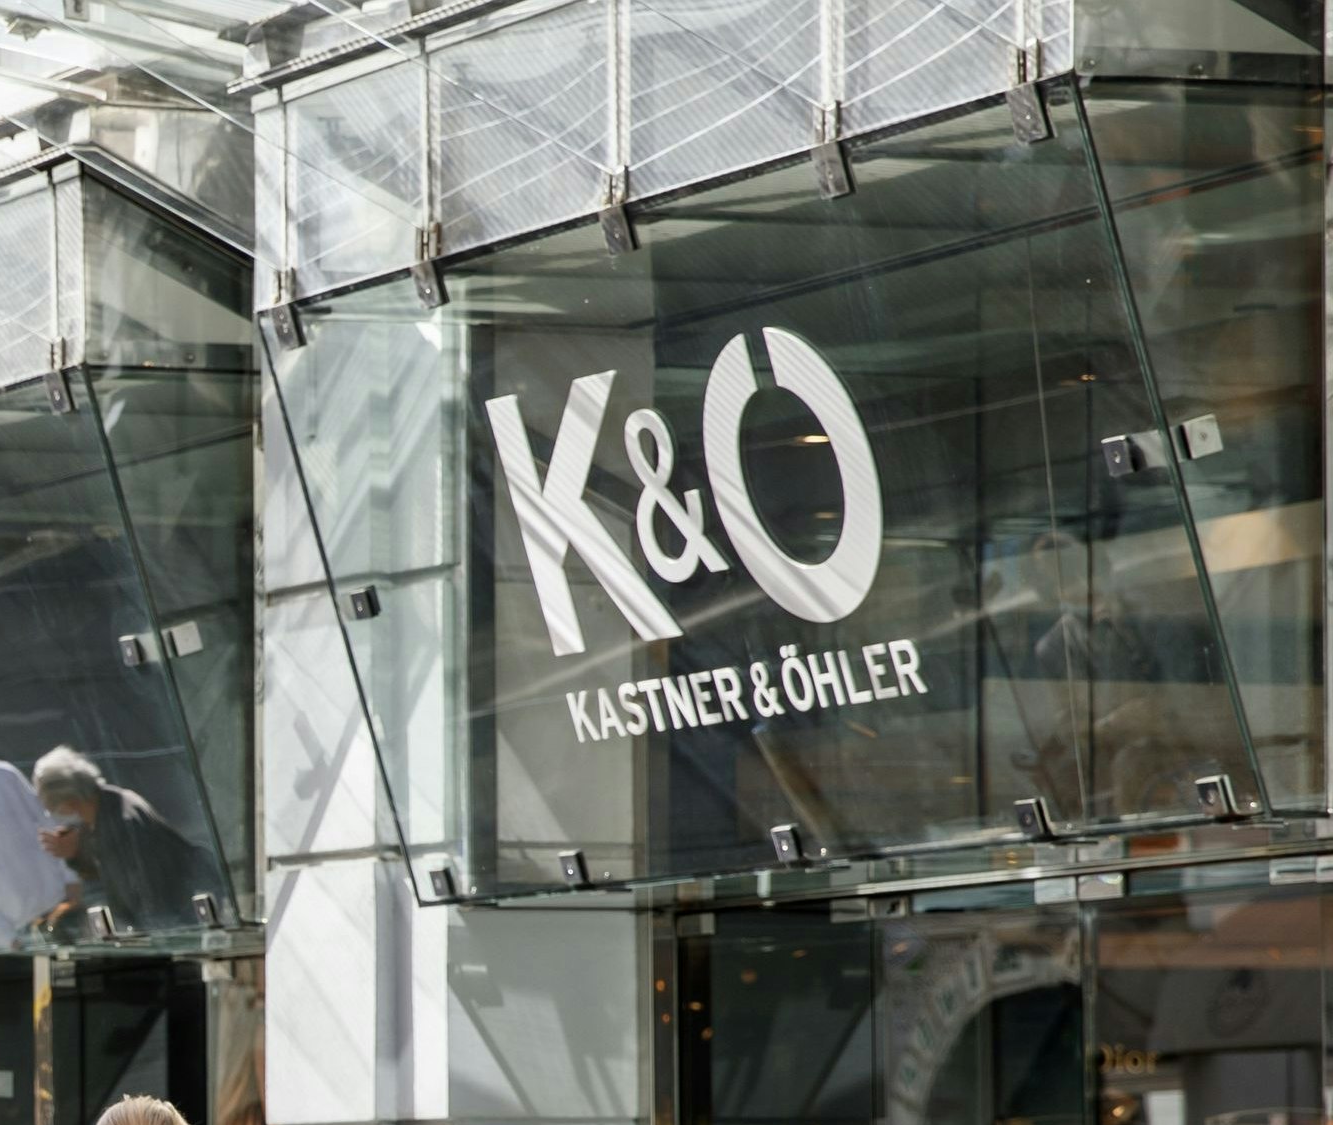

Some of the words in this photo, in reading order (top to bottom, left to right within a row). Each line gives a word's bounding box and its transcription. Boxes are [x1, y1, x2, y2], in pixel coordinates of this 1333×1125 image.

[566, 665, 748, 743] KASTNER
[752, 661, 785, 719] &
[781, 639, 928, 712] ÖHLER
